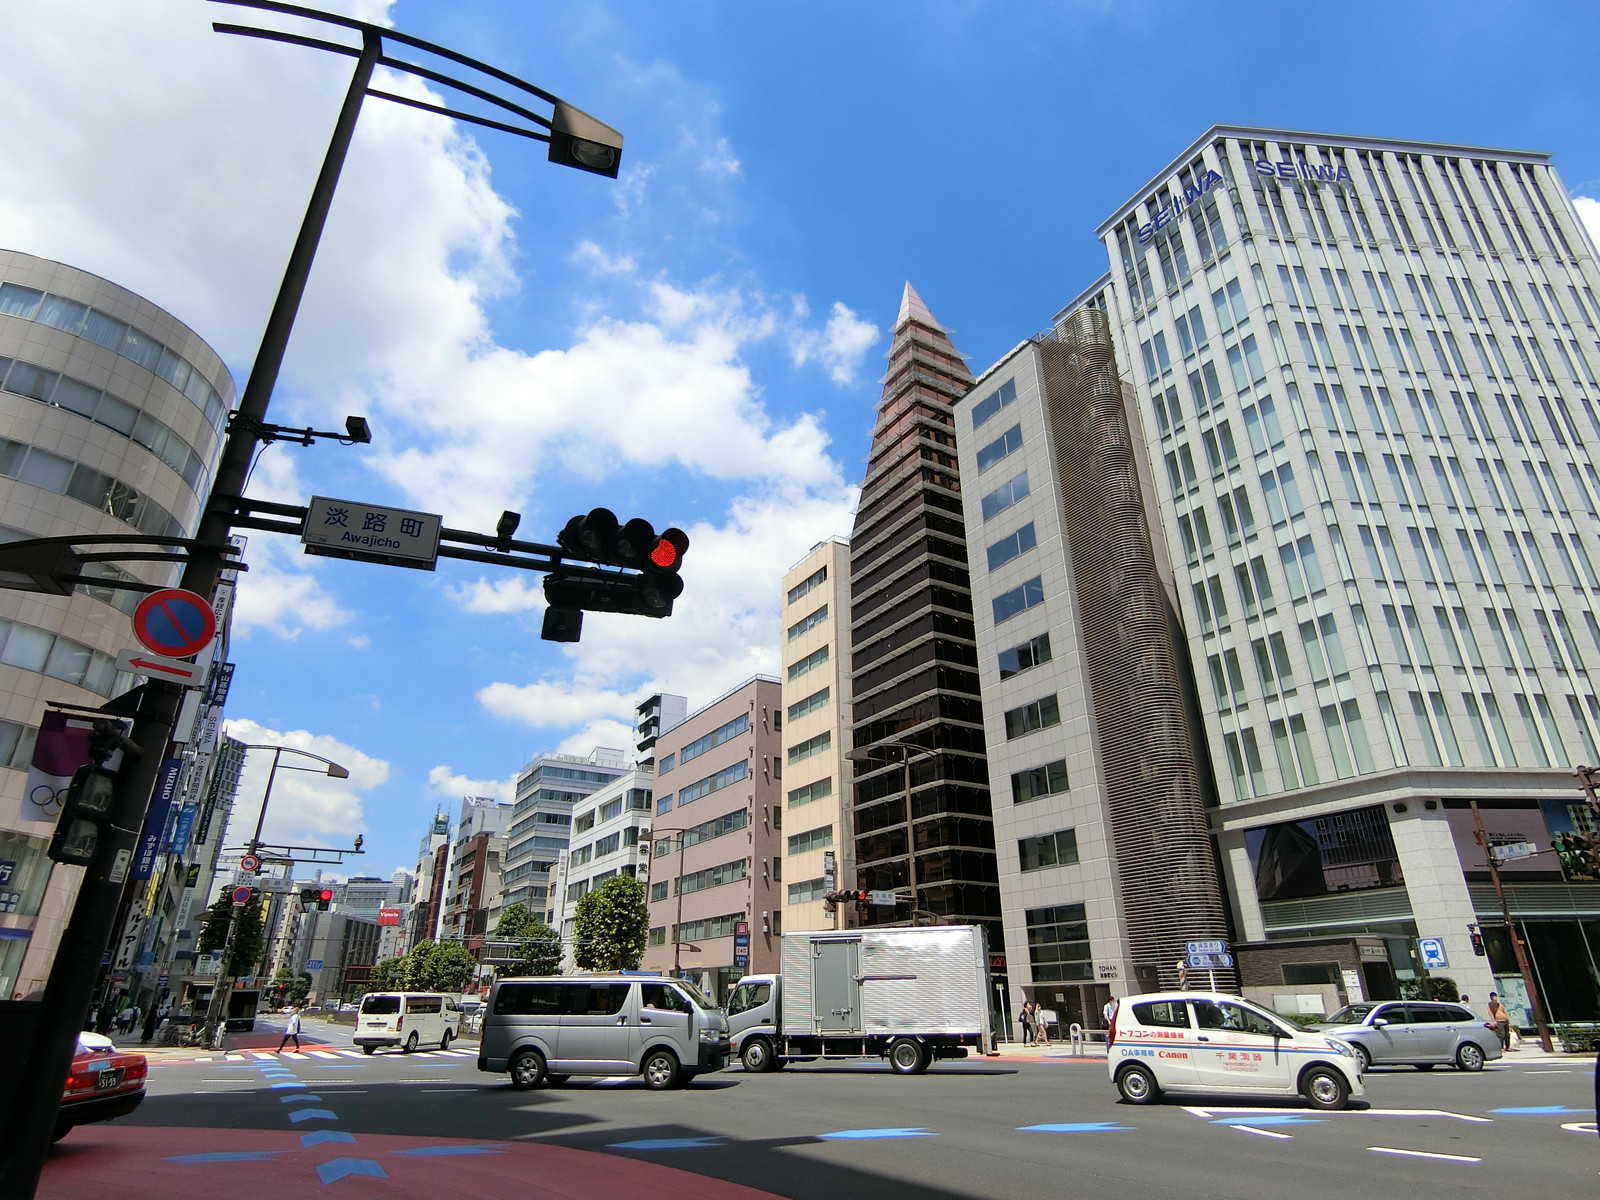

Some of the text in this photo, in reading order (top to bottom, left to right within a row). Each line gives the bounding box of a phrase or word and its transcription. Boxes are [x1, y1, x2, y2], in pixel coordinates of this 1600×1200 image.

[1255, 159, 1354, 183] SEIWA
[1137, 169, 1223, 245] SEIWA
[324, 507, 425, 538] 淡路町
[341, 531, 401, 550] Awajicho
[203, 716, 217, 744] SEIWA
[162, 767, 179, 800] MIZUHO
[139, 834, 158, 873] みずほ銀行
[117, 913, 145, 969] ルノアール
[1158, 1050, 1188, 1060] Canon
